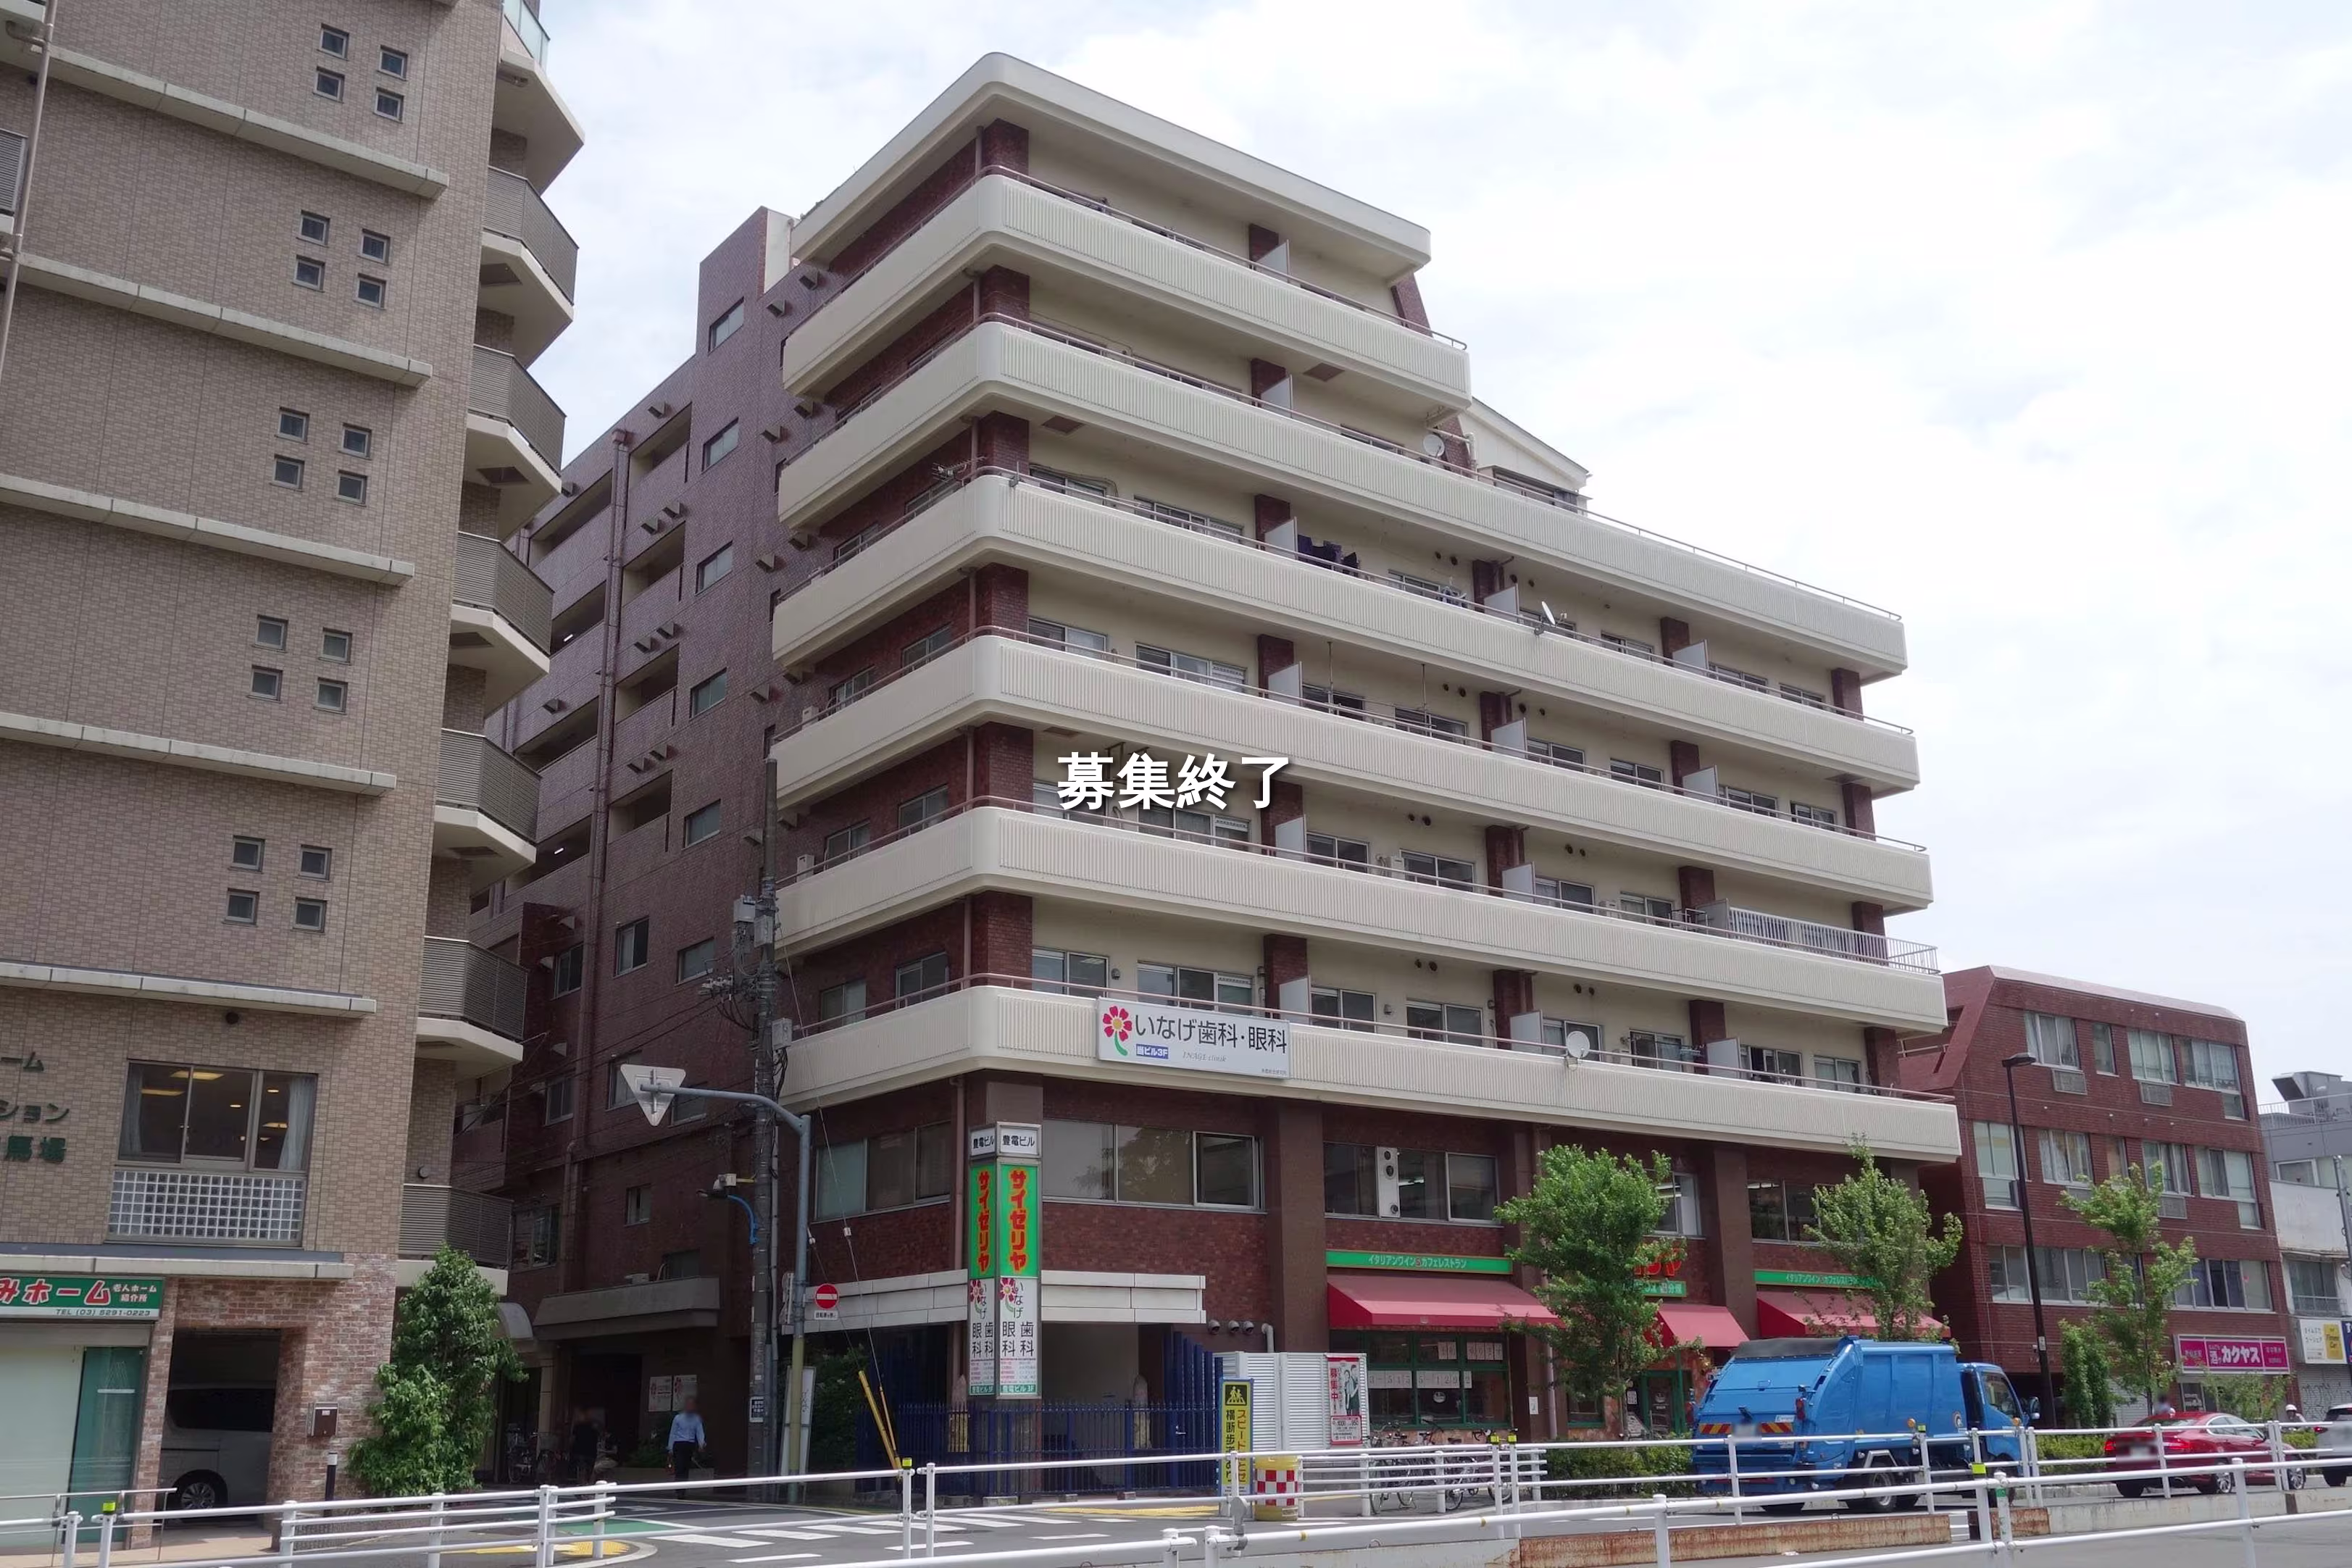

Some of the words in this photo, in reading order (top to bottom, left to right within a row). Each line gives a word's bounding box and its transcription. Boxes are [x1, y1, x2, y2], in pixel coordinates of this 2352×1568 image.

[1135, 1014, 1287, 1054] いなげ歯科・眼科
[978, 1169, 990, 1272] サイゼリヤ
[1009, 1169, 1027, 1272] サイゼリヤ
